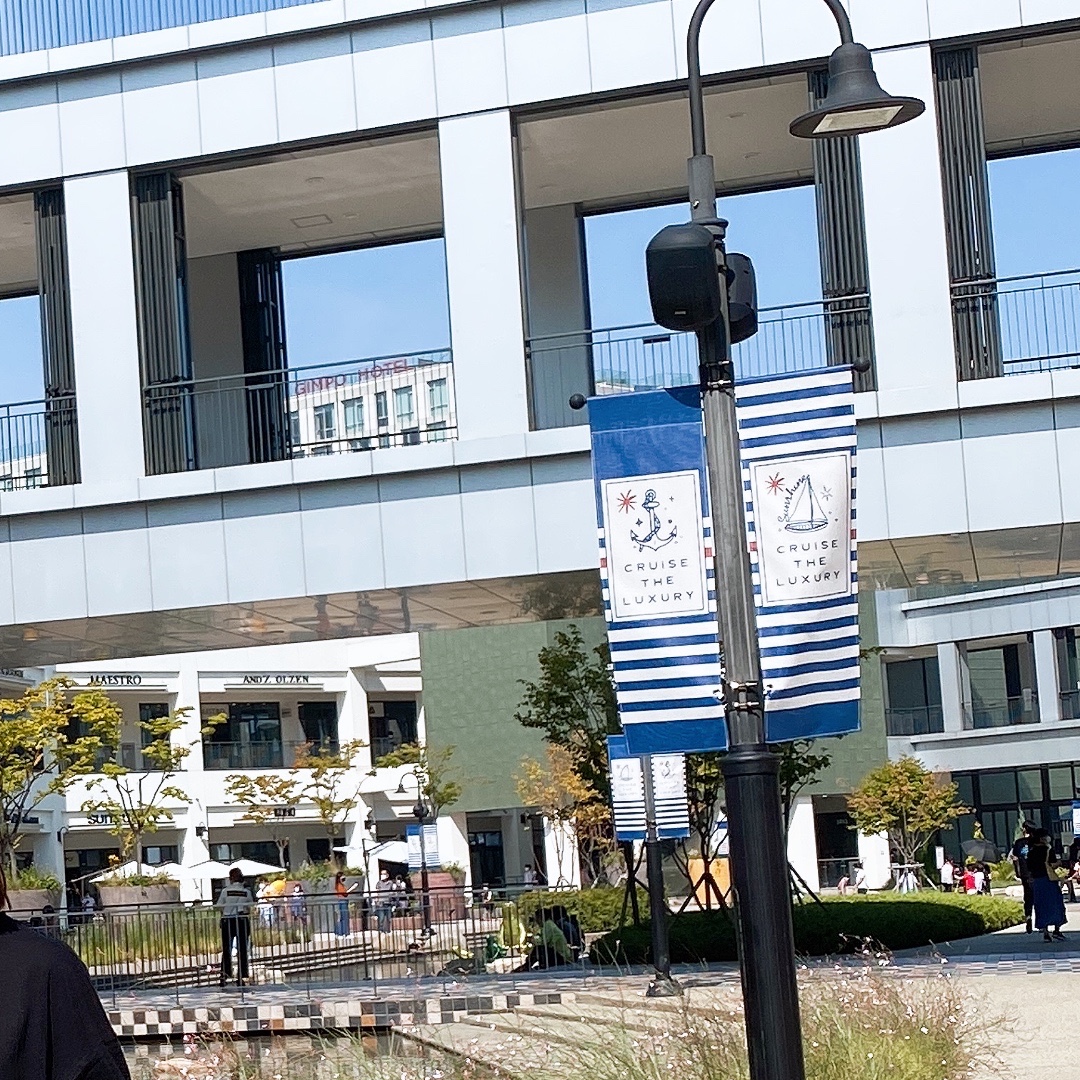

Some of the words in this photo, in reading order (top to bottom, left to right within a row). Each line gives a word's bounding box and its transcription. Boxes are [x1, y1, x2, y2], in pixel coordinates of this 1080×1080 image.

[358, 358, 413, 381] HOTEL
[777, 539, 839, 554] CRUISE
[624, 558, 688, 572] CRUISE
[794, 556, 827, 569] THE
[641, 576, 674, 587] THE
[776, 570, 840, 586] LUXURY
[623, 591, 694, 605] LUXURY
[89, 674, 142, 686] MAESTRO
[275, 674, 310, 684] OLZEN
